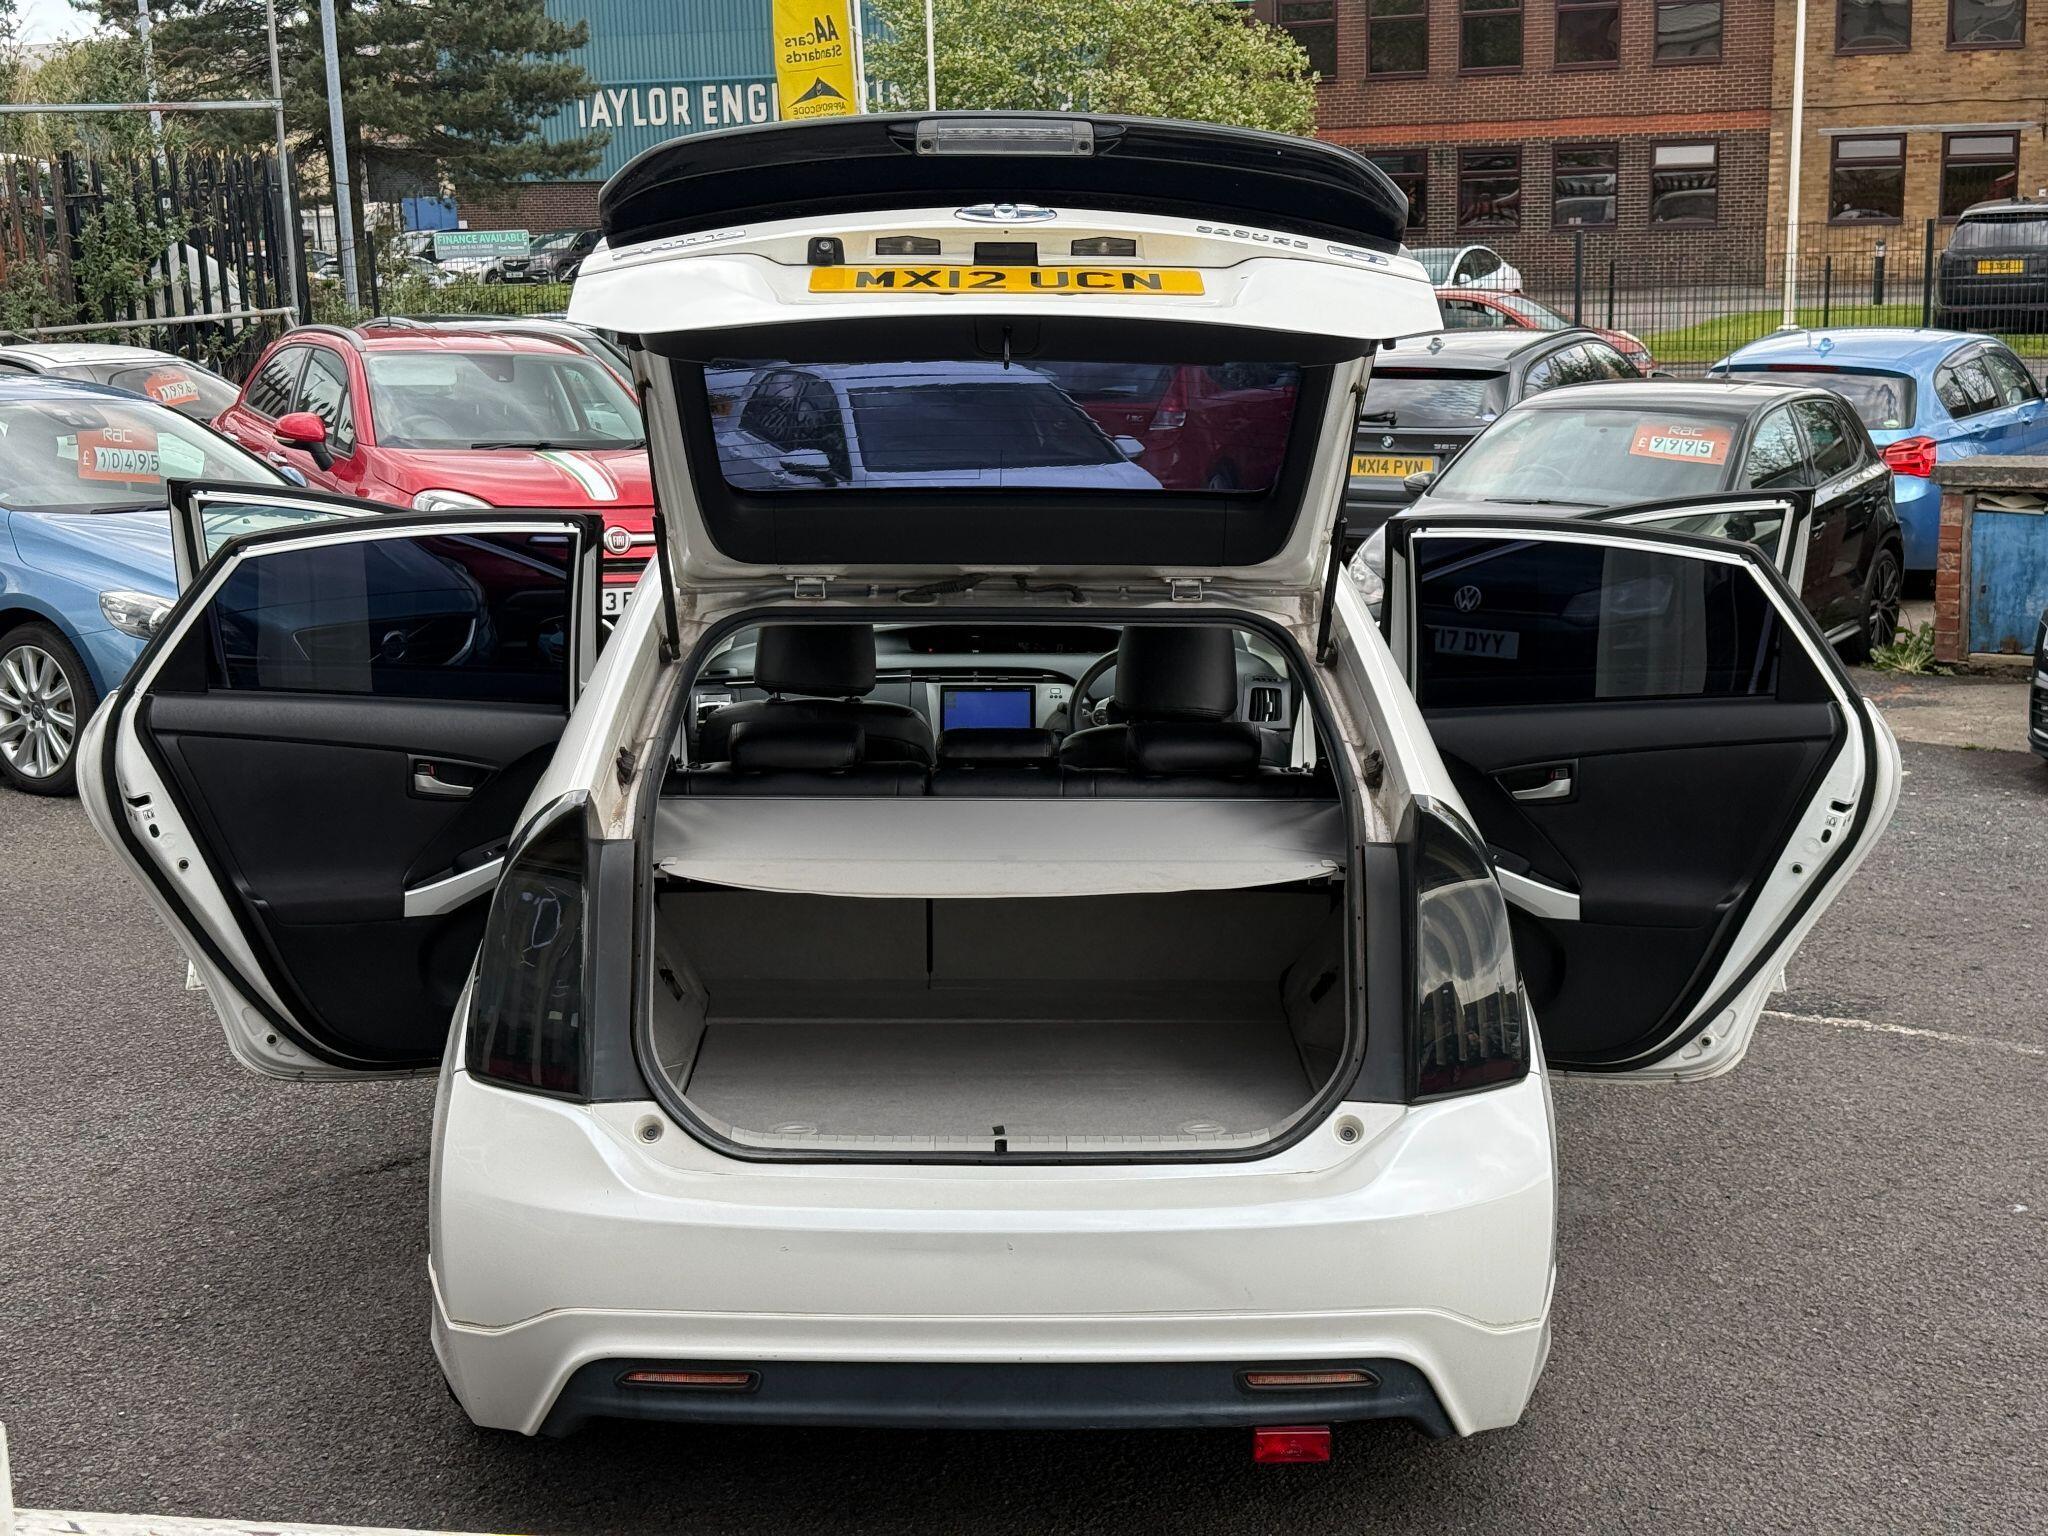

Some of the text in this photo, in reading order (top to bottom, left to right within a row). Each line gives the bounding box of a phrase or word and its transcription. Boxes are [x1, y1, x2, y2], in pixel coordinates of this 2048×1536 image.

[702, 82, 780, 125] ENGI
[437, 232, 528, 244] FINANCE AVAILABLE
[856, 270, 1162, 290] MX12 UCN
[1653, 437, 1710, 454] 9995
[1357, 458, 1424, 474] MX14 PVN
[1465, 630, 1506, 654] DYY
